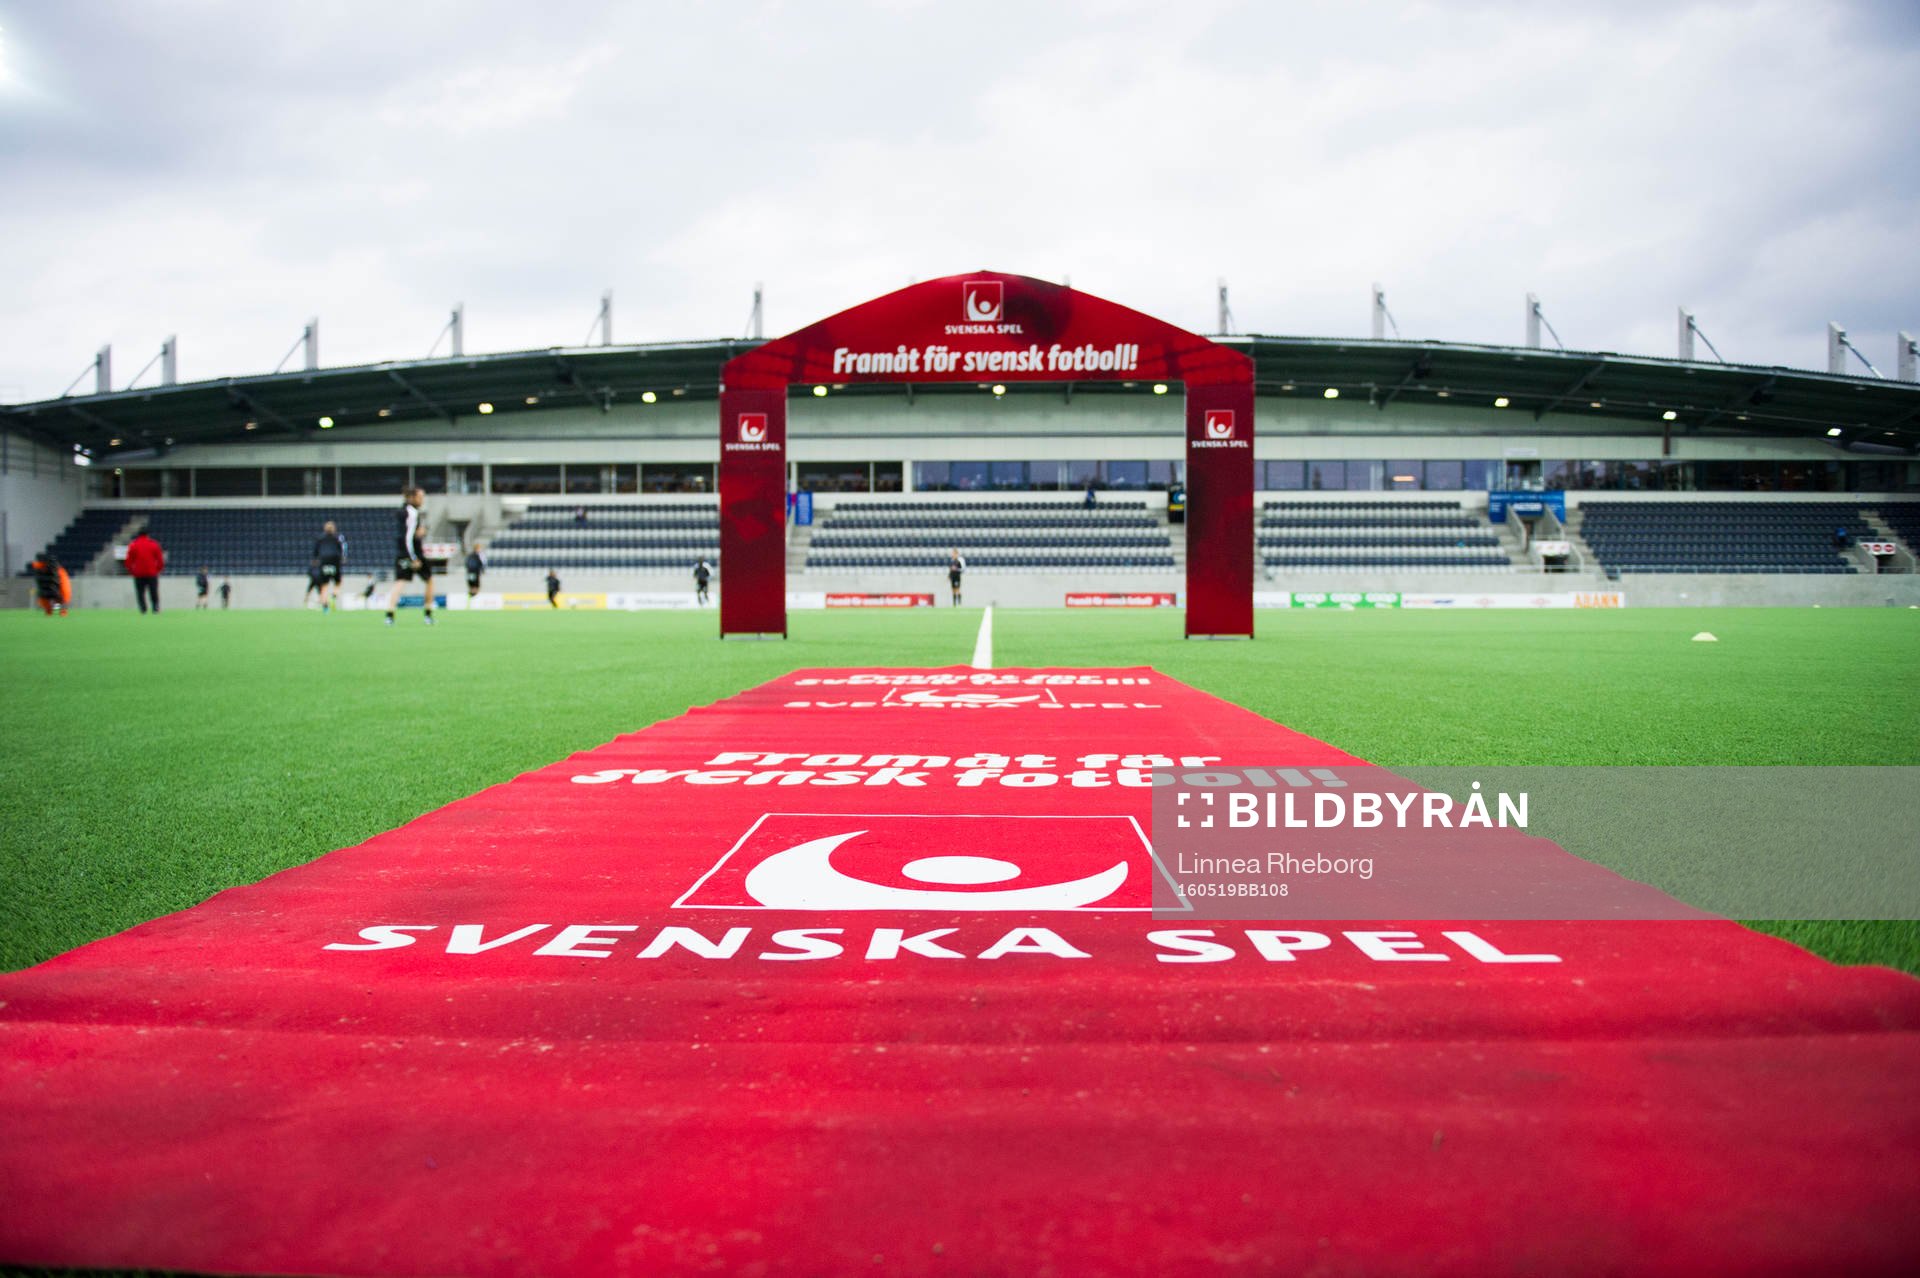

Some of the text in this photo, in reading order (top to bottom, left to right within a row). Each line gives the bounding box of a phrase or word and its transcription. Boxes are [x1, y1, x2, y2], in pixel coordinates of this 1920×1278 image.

[945, 324, 1023, 334] SVENSKA SPEL
[833, 343, 1139, 374] Framåt för svensk fotboll!
[704, 752, 1222, 769] Framåt för
[571, 767, 1348, 788] svensk fotboll!
[321, 923, 1563, 963] SVENSKA SPEL
